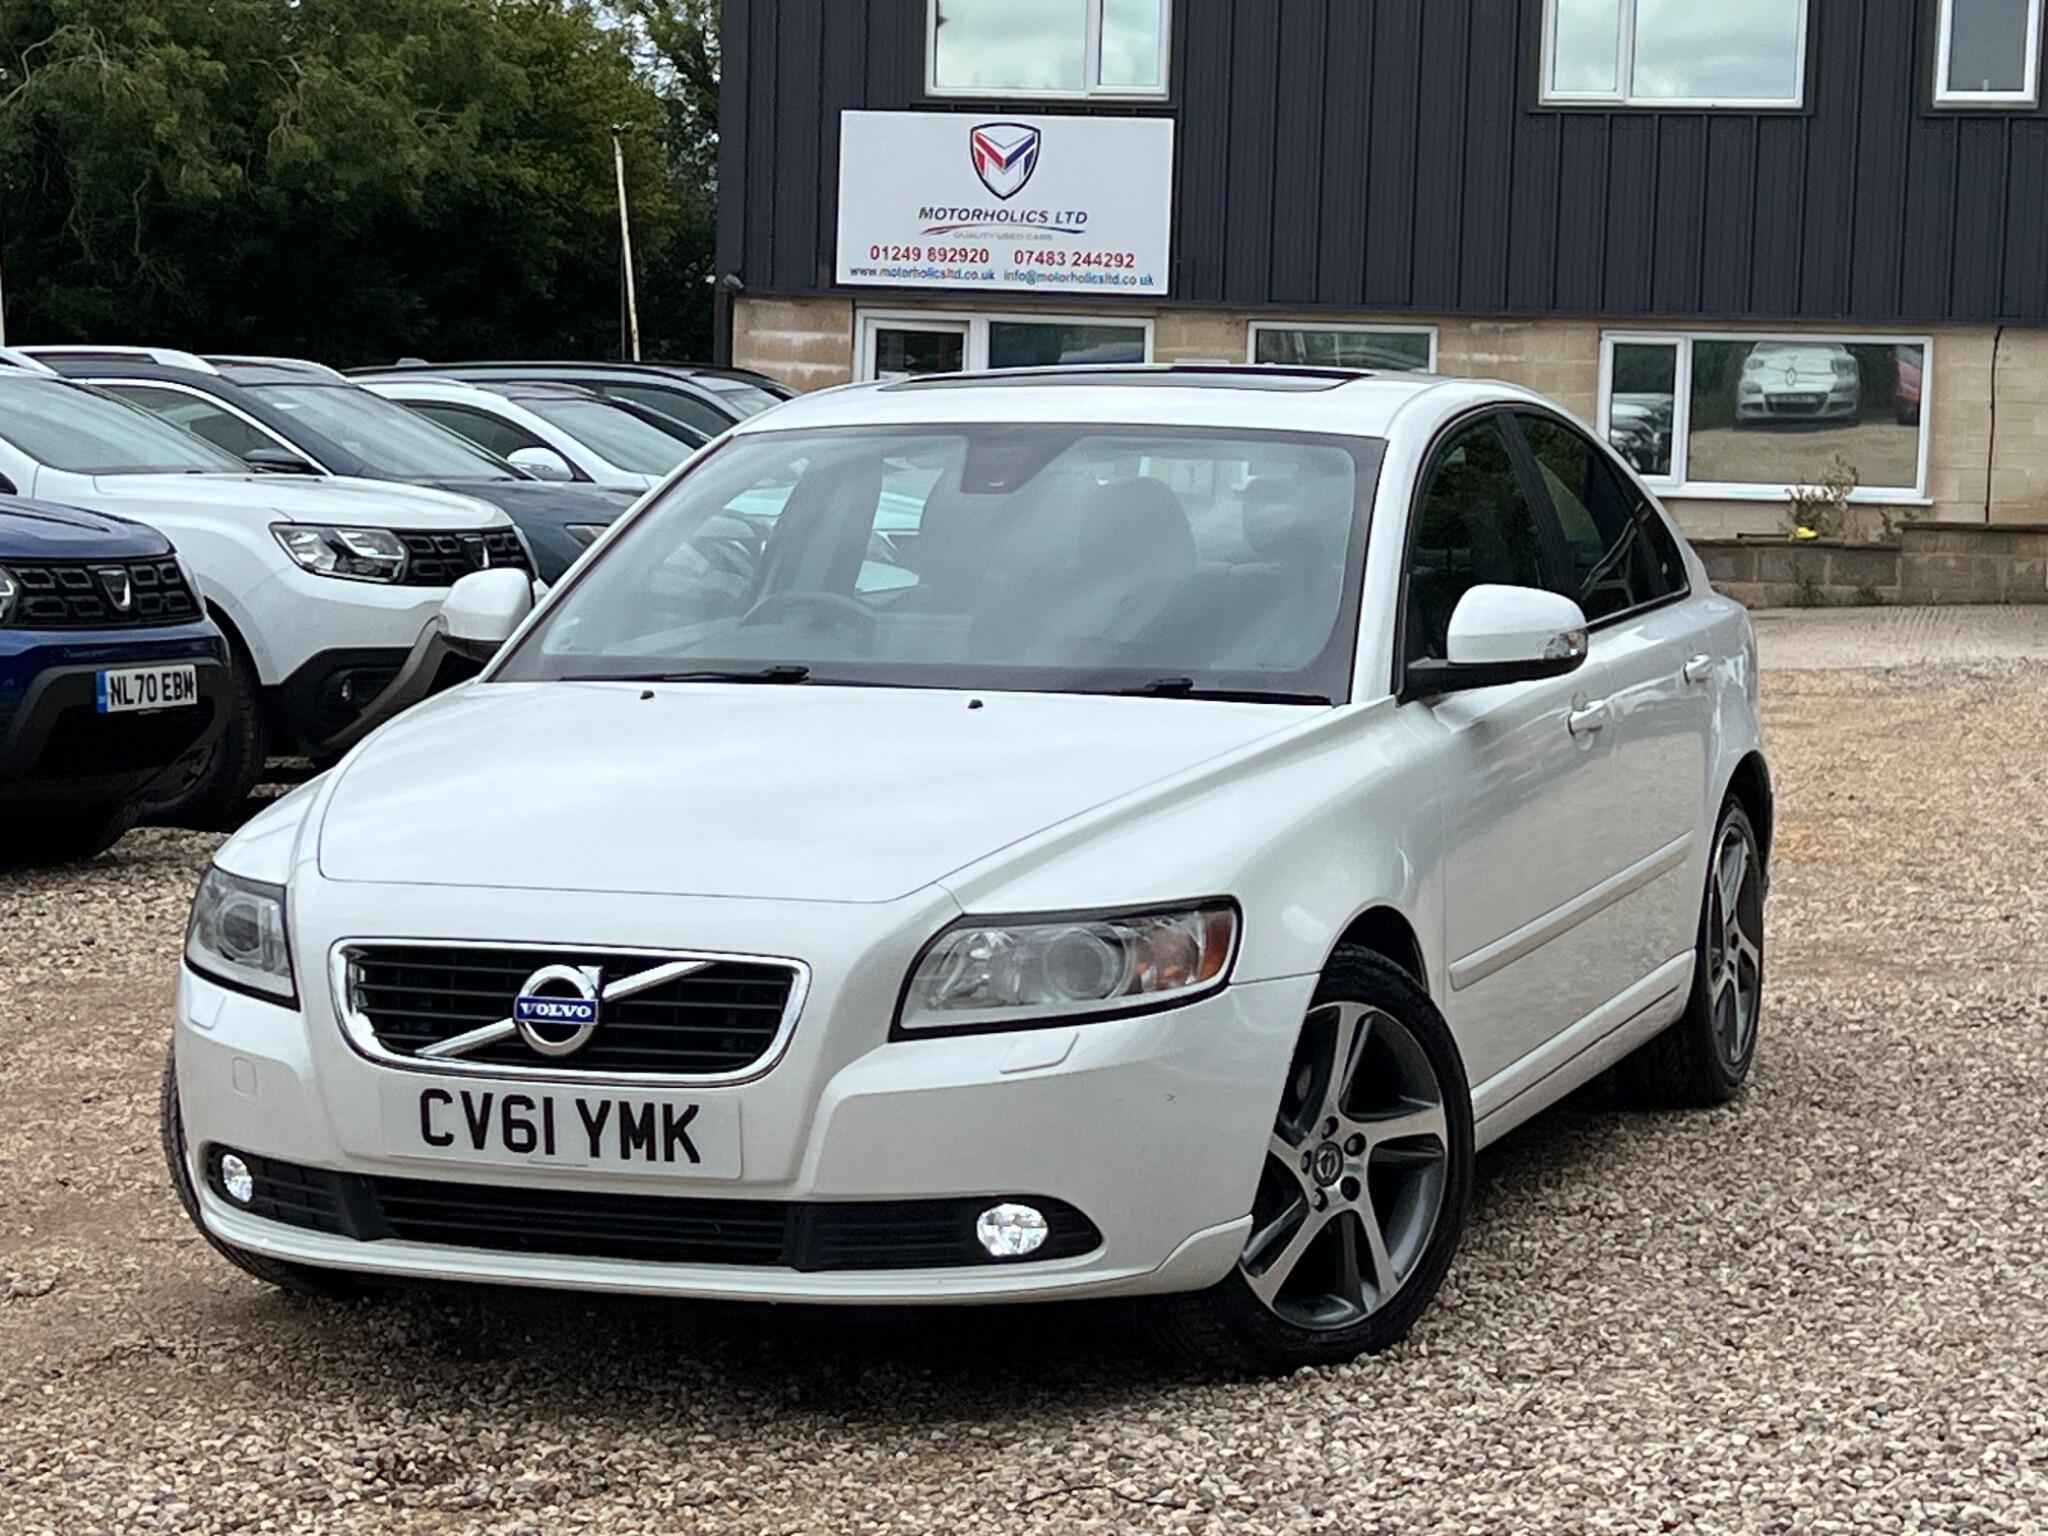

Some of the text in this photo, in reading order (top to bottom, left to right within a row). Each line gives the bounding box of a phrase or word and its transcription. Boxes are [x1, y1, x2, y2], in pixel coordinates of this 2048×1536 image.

[918, 207, 1088, 224] MOTORHOLICS LTD
[870, 245, 989, 264] 01249 892920
[1014, 250, 1135, 268] 07483 244292
[1004, 269, 1154, 286] info@motorholicsltd.couk
[110, 674, 157, 706] NL70
[520, 1002, 592, 1018] VOLVO
[419, 1088, 701, 1164] CV61 YMK
